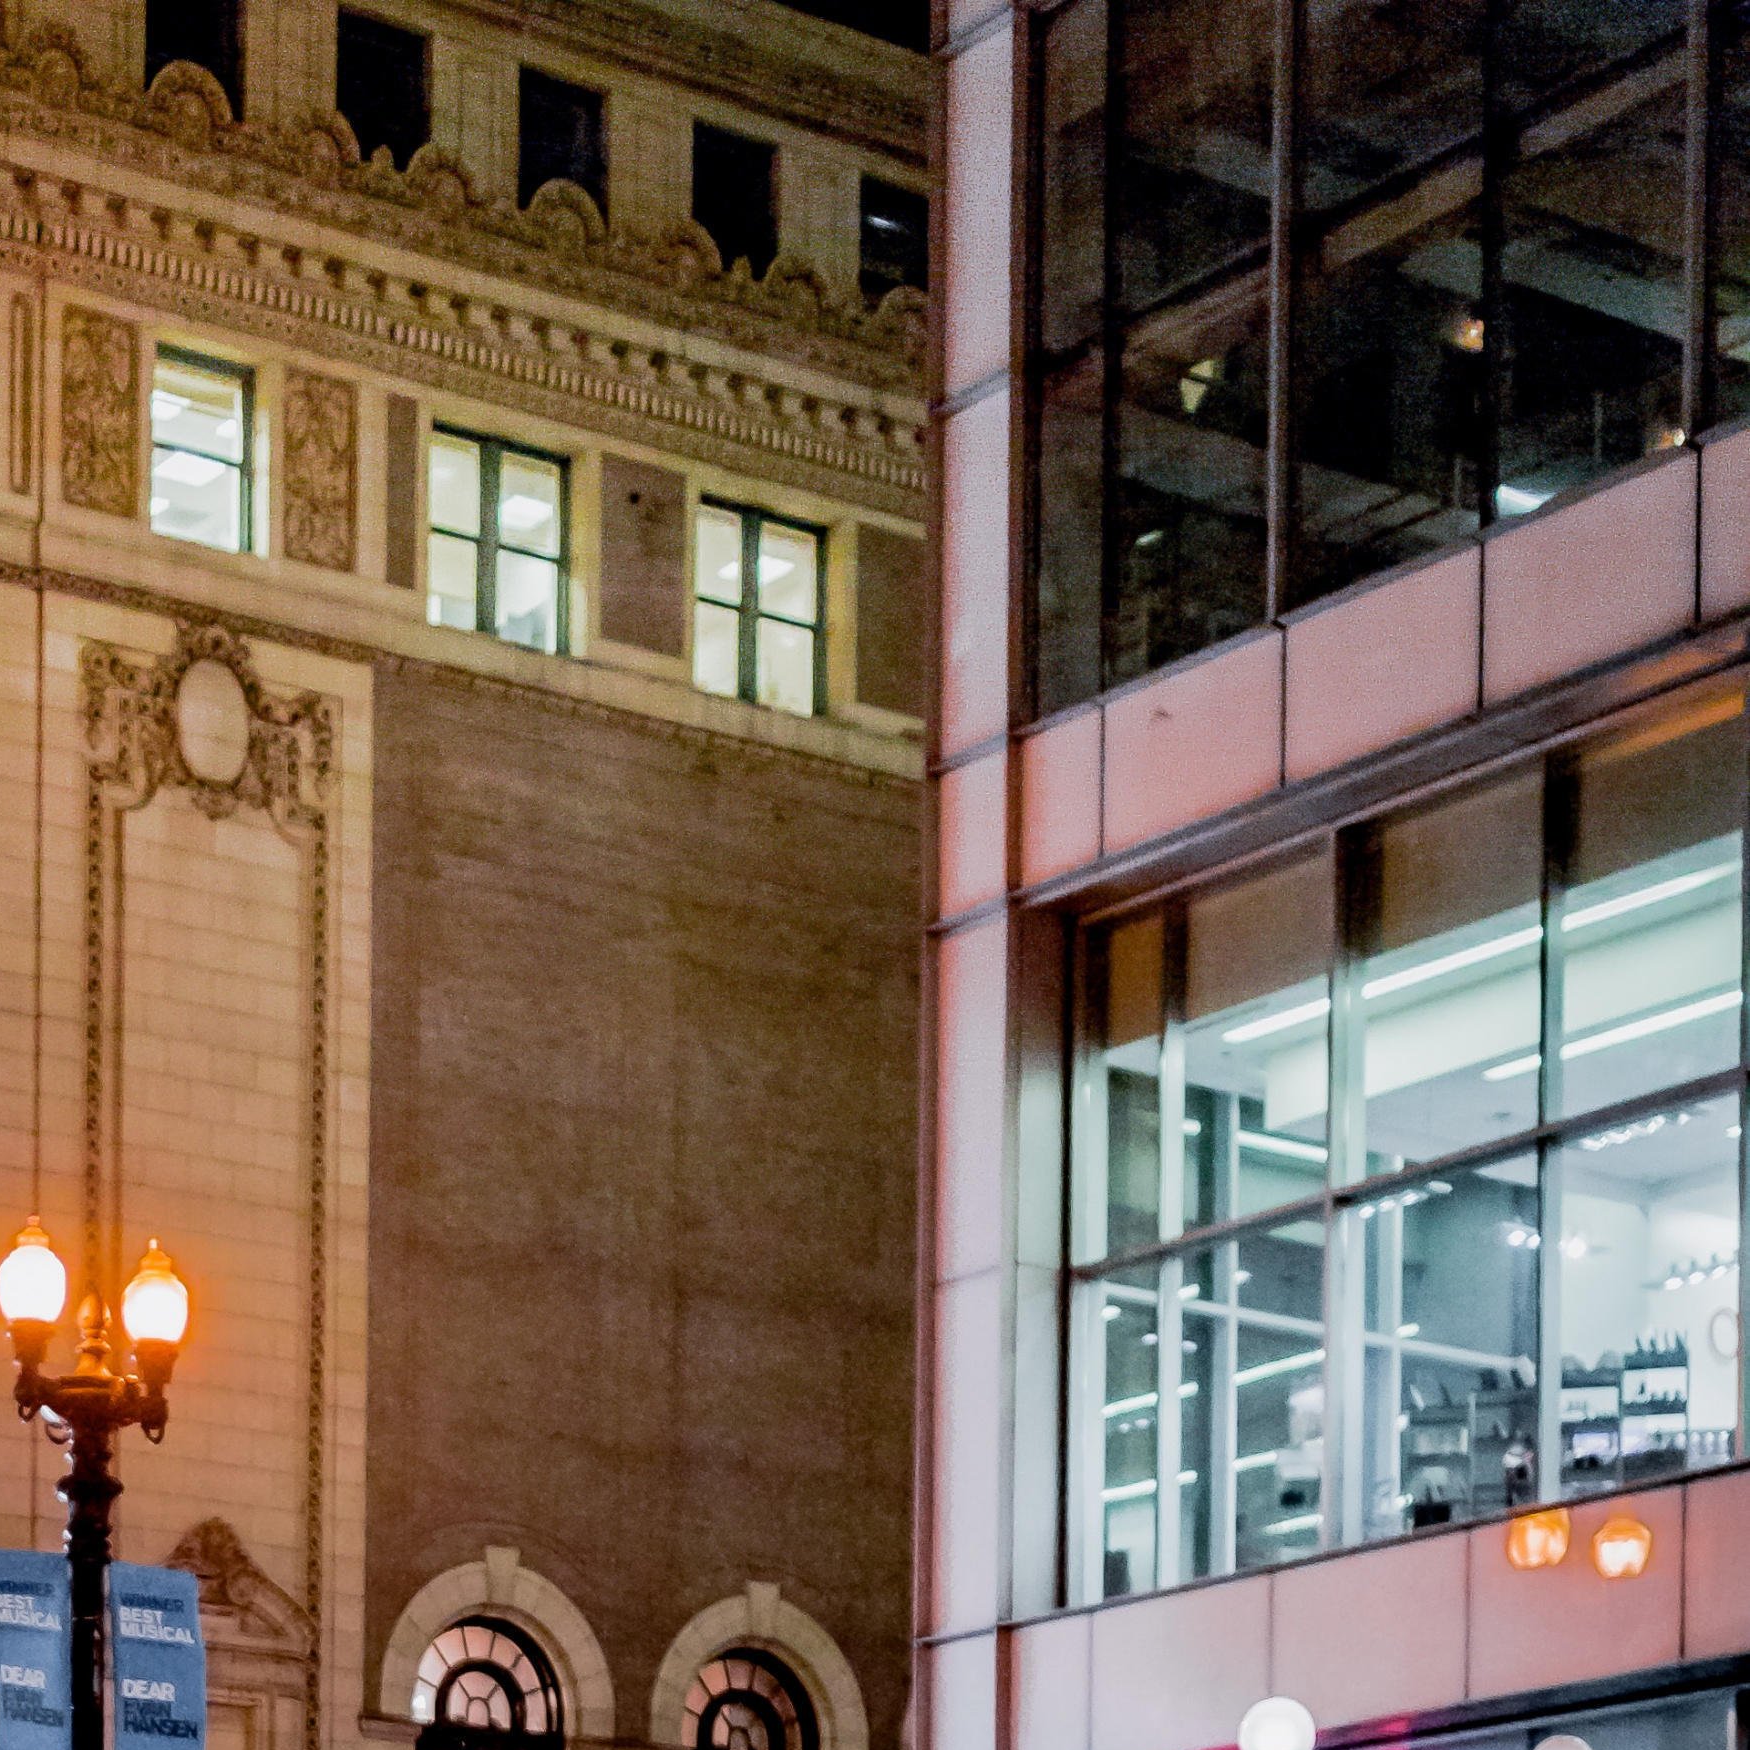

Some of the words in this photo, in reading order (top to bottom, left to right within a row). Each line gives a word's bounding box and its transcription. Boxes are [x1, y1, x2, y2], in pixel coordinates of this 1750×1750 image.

[119, 1605, 163, 1623] BEST
[120, 1621, 195, 1644] MUSICAL
[0, 1664, 46, 1689] DEAR
[121, 1678, 176, 1702] DEAR
[123, 1713, 199, 1739] HANSEN
